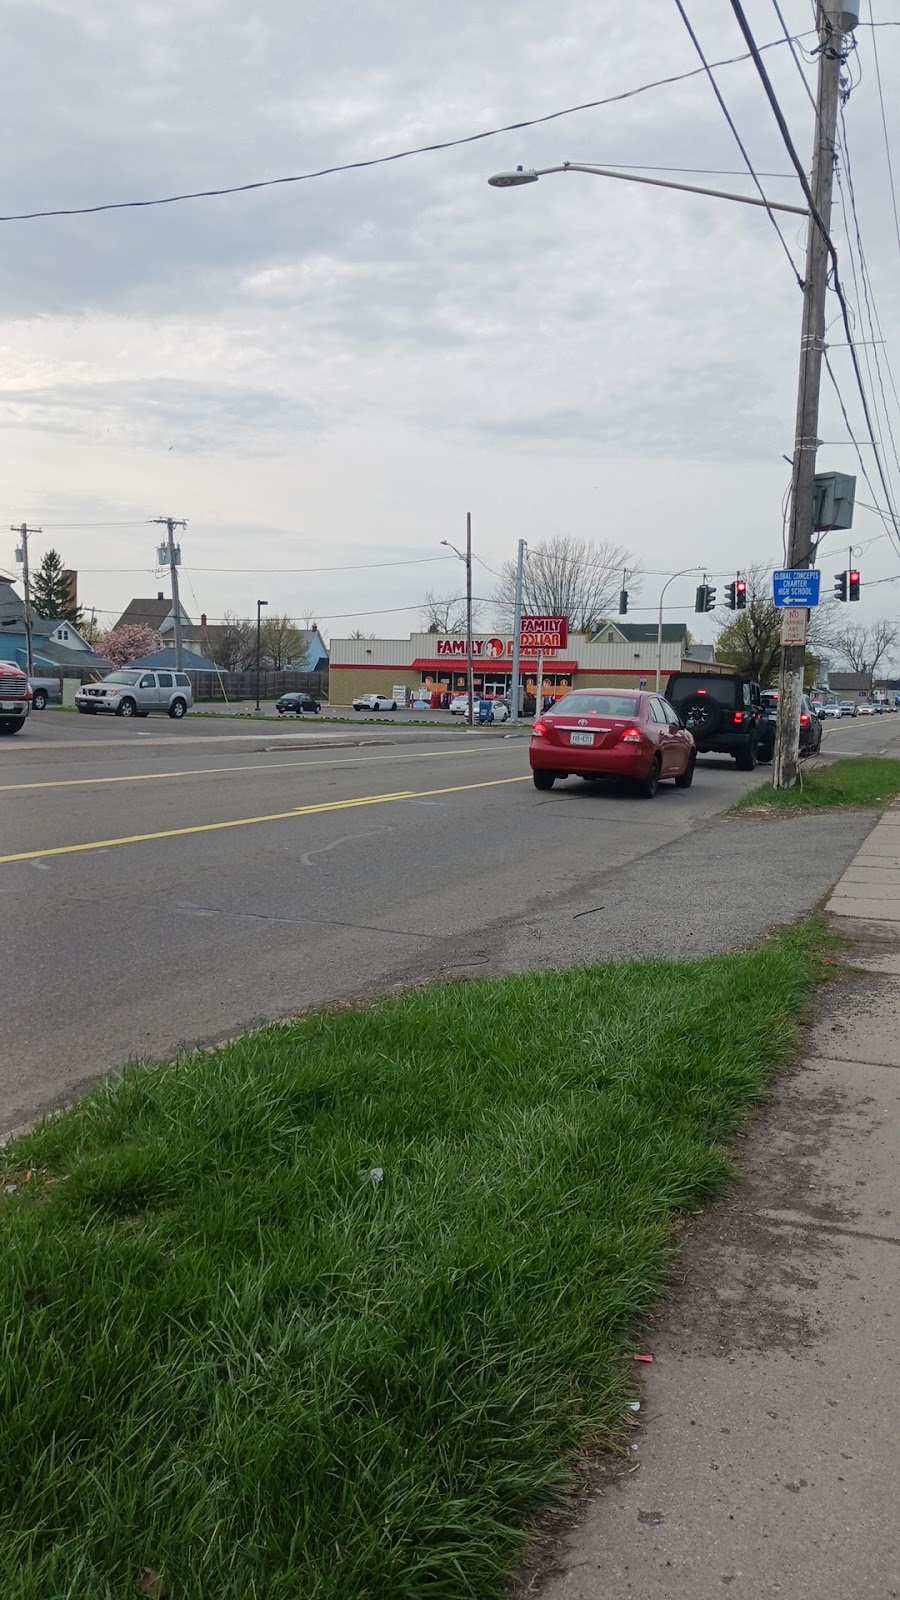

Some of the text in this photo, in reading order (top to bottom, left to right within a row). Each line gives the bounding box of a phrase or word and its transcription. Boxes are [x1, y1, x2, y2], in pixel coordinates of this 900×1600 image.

[793, 572, 819, 580] CONCEPTS
[521, 619, 562, 632] FAMILY
[520, 633, 560, 646] DOLLAR
[436, 639, 484, 655] FAMILY
